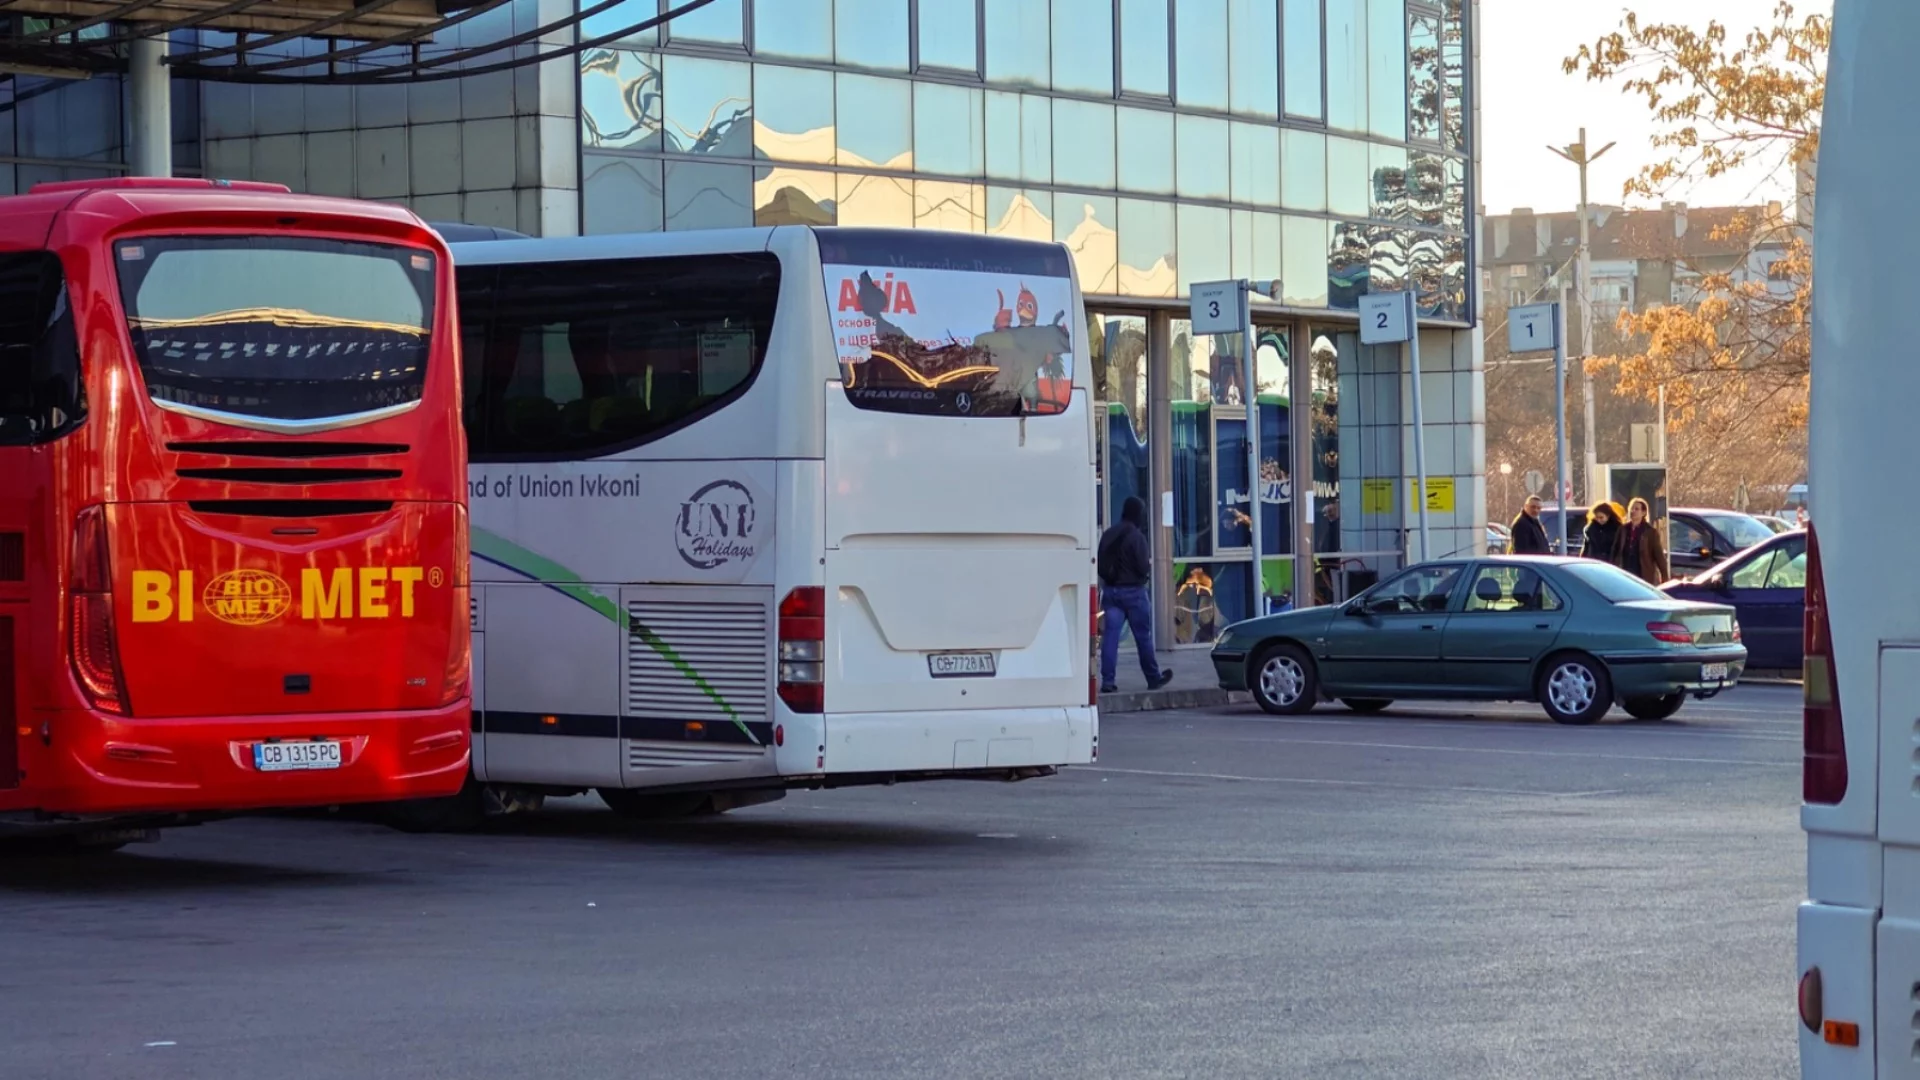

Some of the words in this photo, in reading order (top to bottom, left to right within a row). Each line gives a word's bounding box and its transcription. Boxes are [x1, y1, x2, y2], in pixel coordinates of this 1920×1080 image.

[1209, 301, 1220, 318] 3
[1377, 312, 1388, 328] 2
[1525, 322, 1533, 338] 1
[854, 389, 936, 400] TRAVEGO
[493, 475, 512, 498] of
[519, 474, 573, 498] Union
[580, 473, 640, 497] Ivkoni
[680, 502, 748, 538] UNI
[691, 536, 754, 561] Holidays
[132, 569, 194, 622] BI
[301, 567, 424, 619] MET
[224, 579, 274, 595] BIO
[217, 599, 281, 615] MET
[264, 746, 282, 762] CB
[286, 744, 318, 762] 1315
[320, 744, 338, 760] PC
